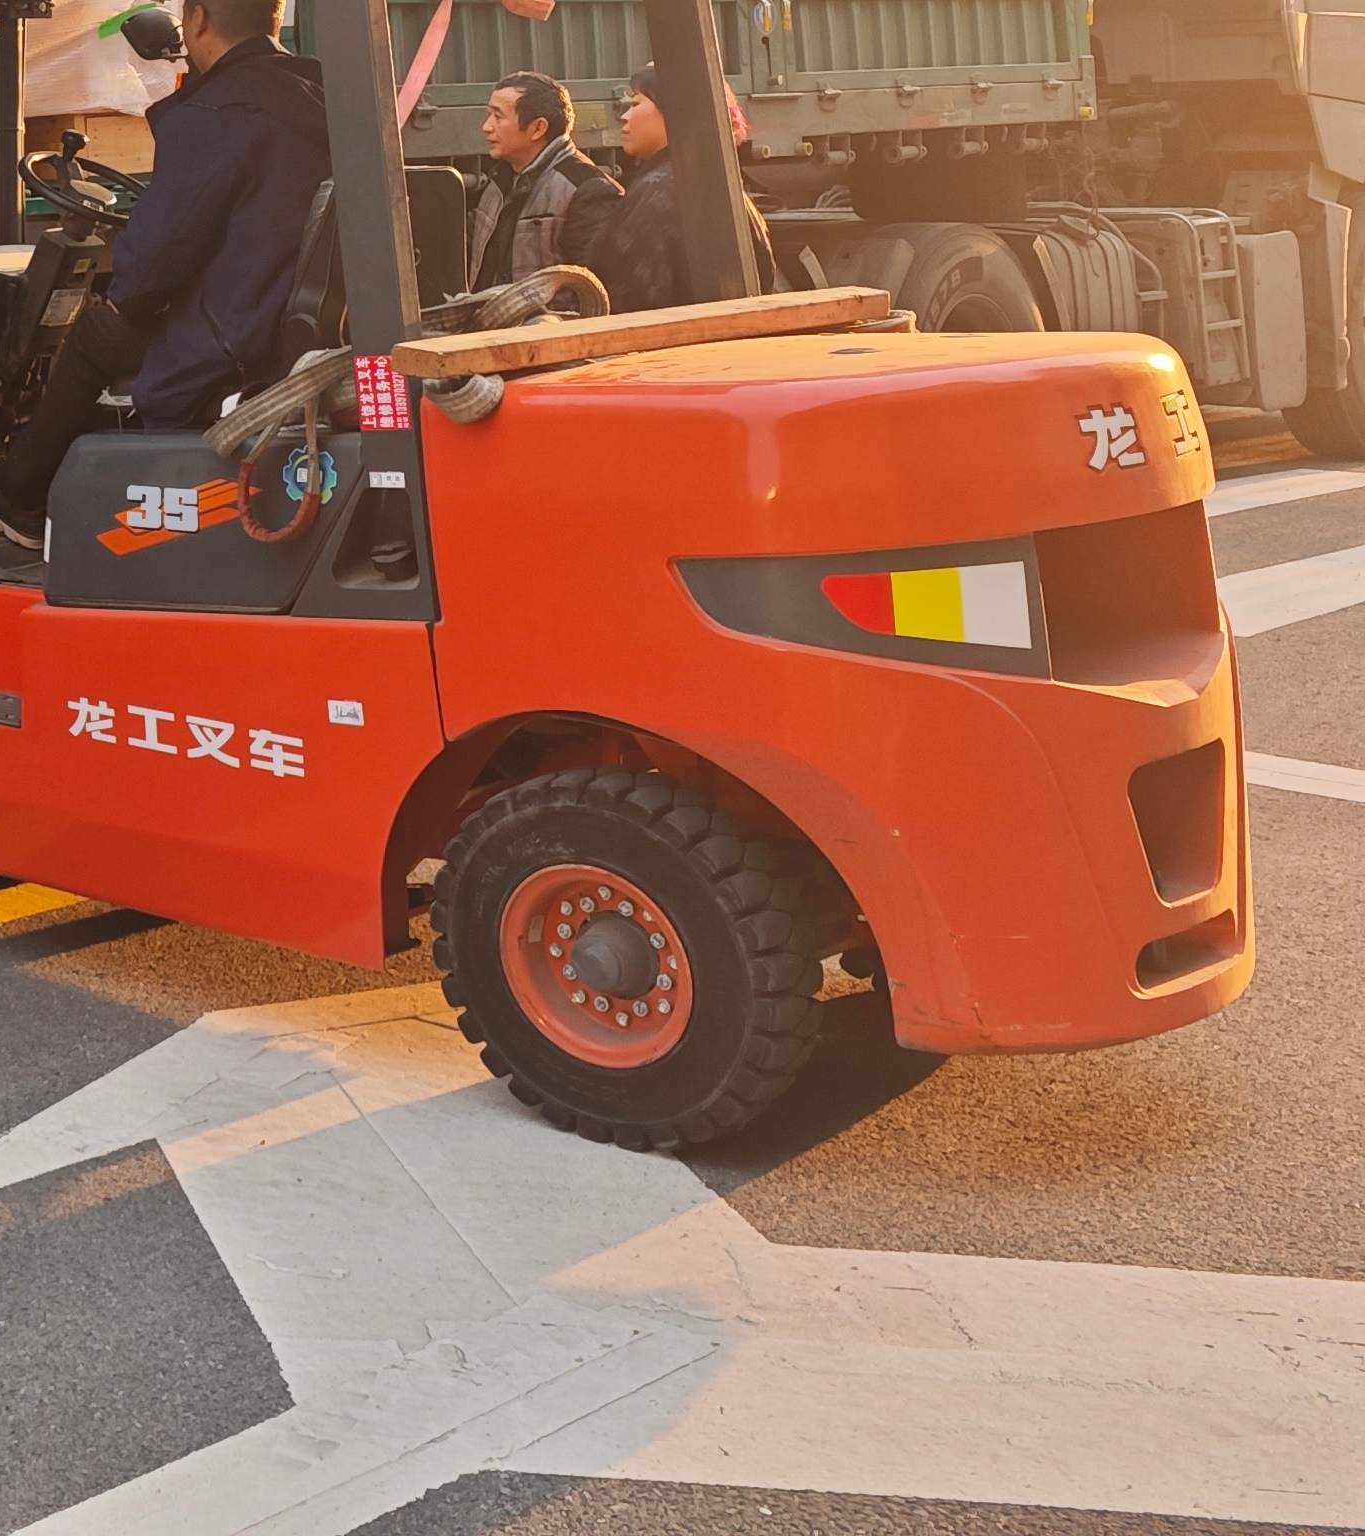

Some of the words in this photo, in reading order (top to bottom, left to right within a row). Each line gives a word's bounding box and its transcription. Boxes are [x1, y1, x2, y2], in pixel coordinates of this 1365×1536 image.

[1077, 390, 1201, 472] 龙工
[127, 485, 199, 532] 35
[68, 697, 305, 778] 龙工叉车
